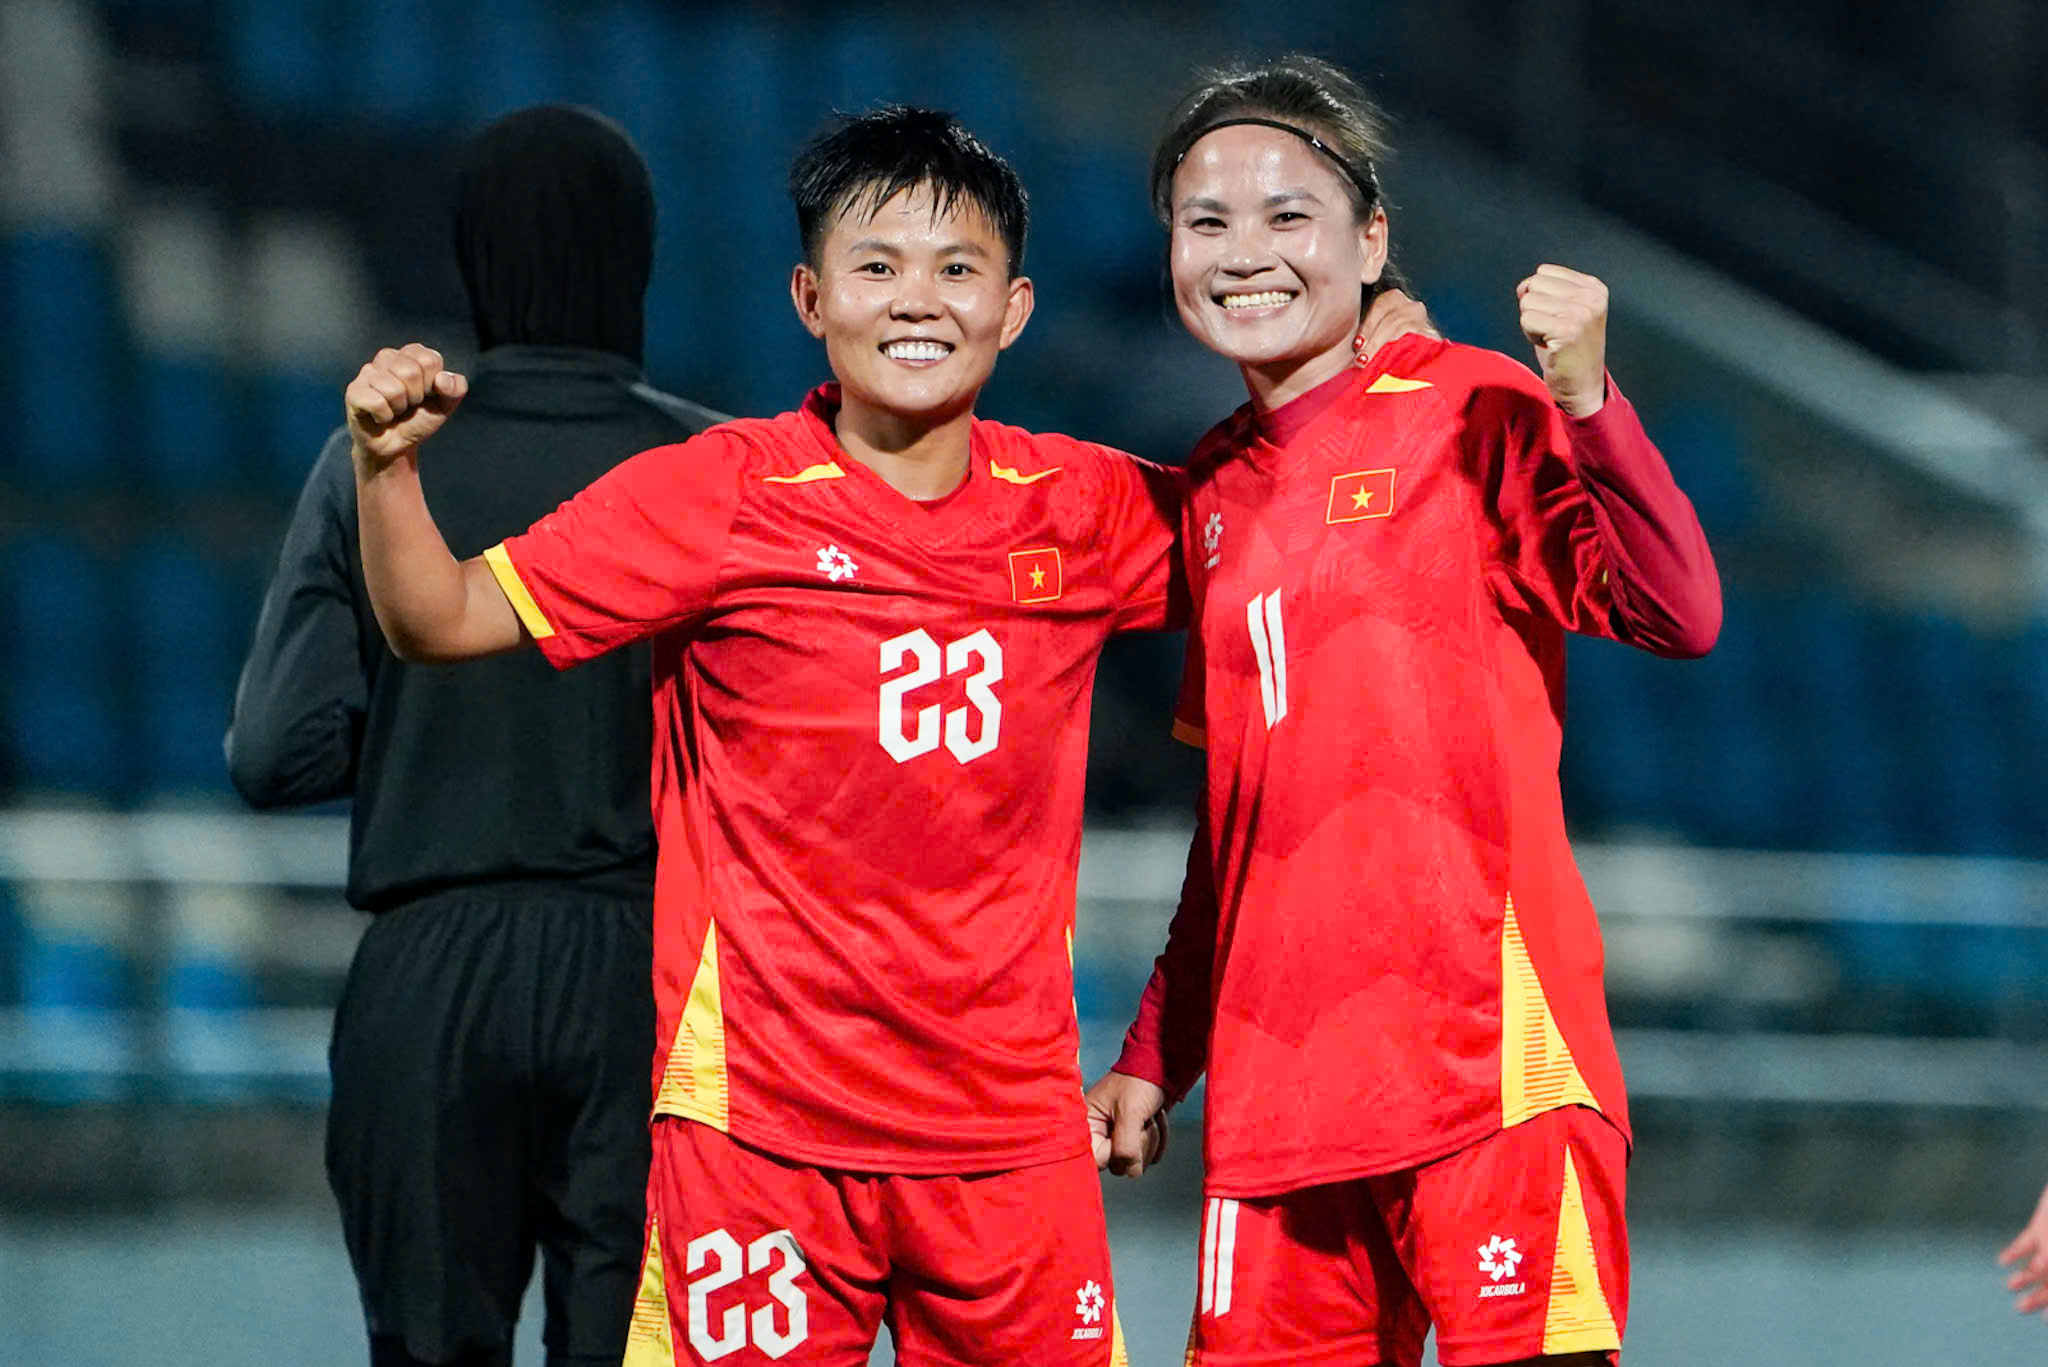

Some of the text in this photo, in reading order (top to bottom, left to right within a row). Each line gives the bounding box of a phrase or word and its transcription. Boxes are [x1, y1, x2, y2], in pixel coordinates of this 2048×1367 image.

[878, 627, 1003, 764] 23
[1246, 587, 1288, 731] 11
[686, 1228, 809, 1363] 23
[1201, 1197, 1240, 1318] 11
